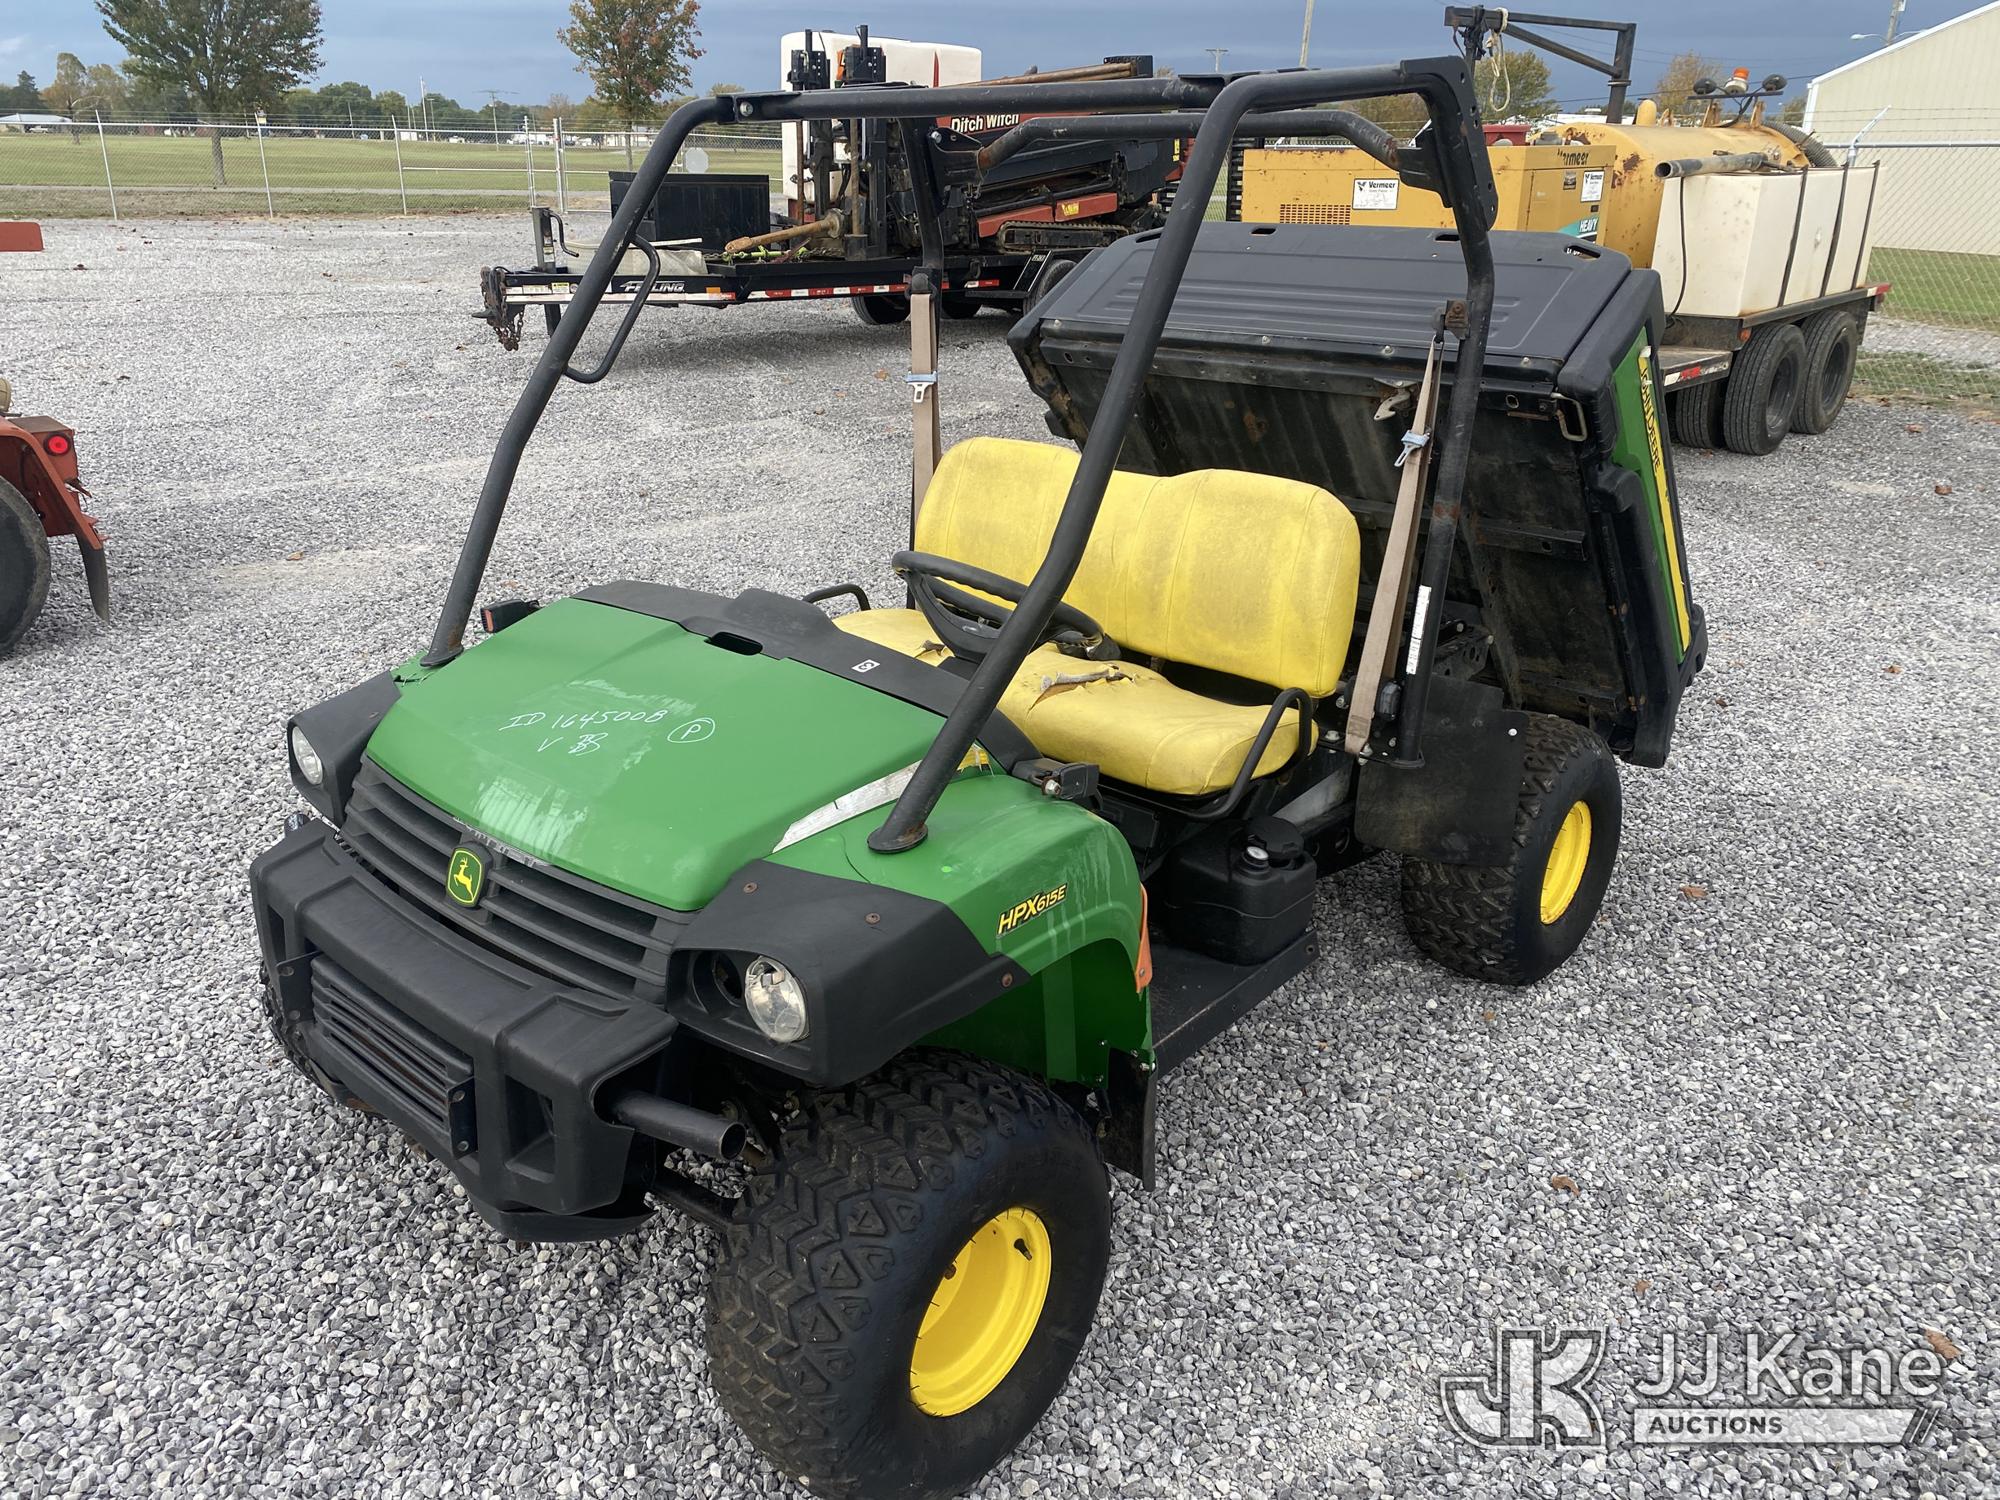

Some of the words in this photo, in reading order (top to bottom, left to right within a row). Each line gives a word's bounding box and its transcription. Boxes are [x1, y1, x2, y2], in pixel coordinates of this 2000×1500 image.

[952, 115, 983, 133] Ditch
[986, 113, 1019, 129] Witch
[1369, 181, 1396, 189] Vermeer
[1579, 218, 1598, 233] HEAVY
[1646, 414, 1661, 472] DEERE
[499, 712, 546, 731] ID
[998, 884, 1067, 935] HPX615E
